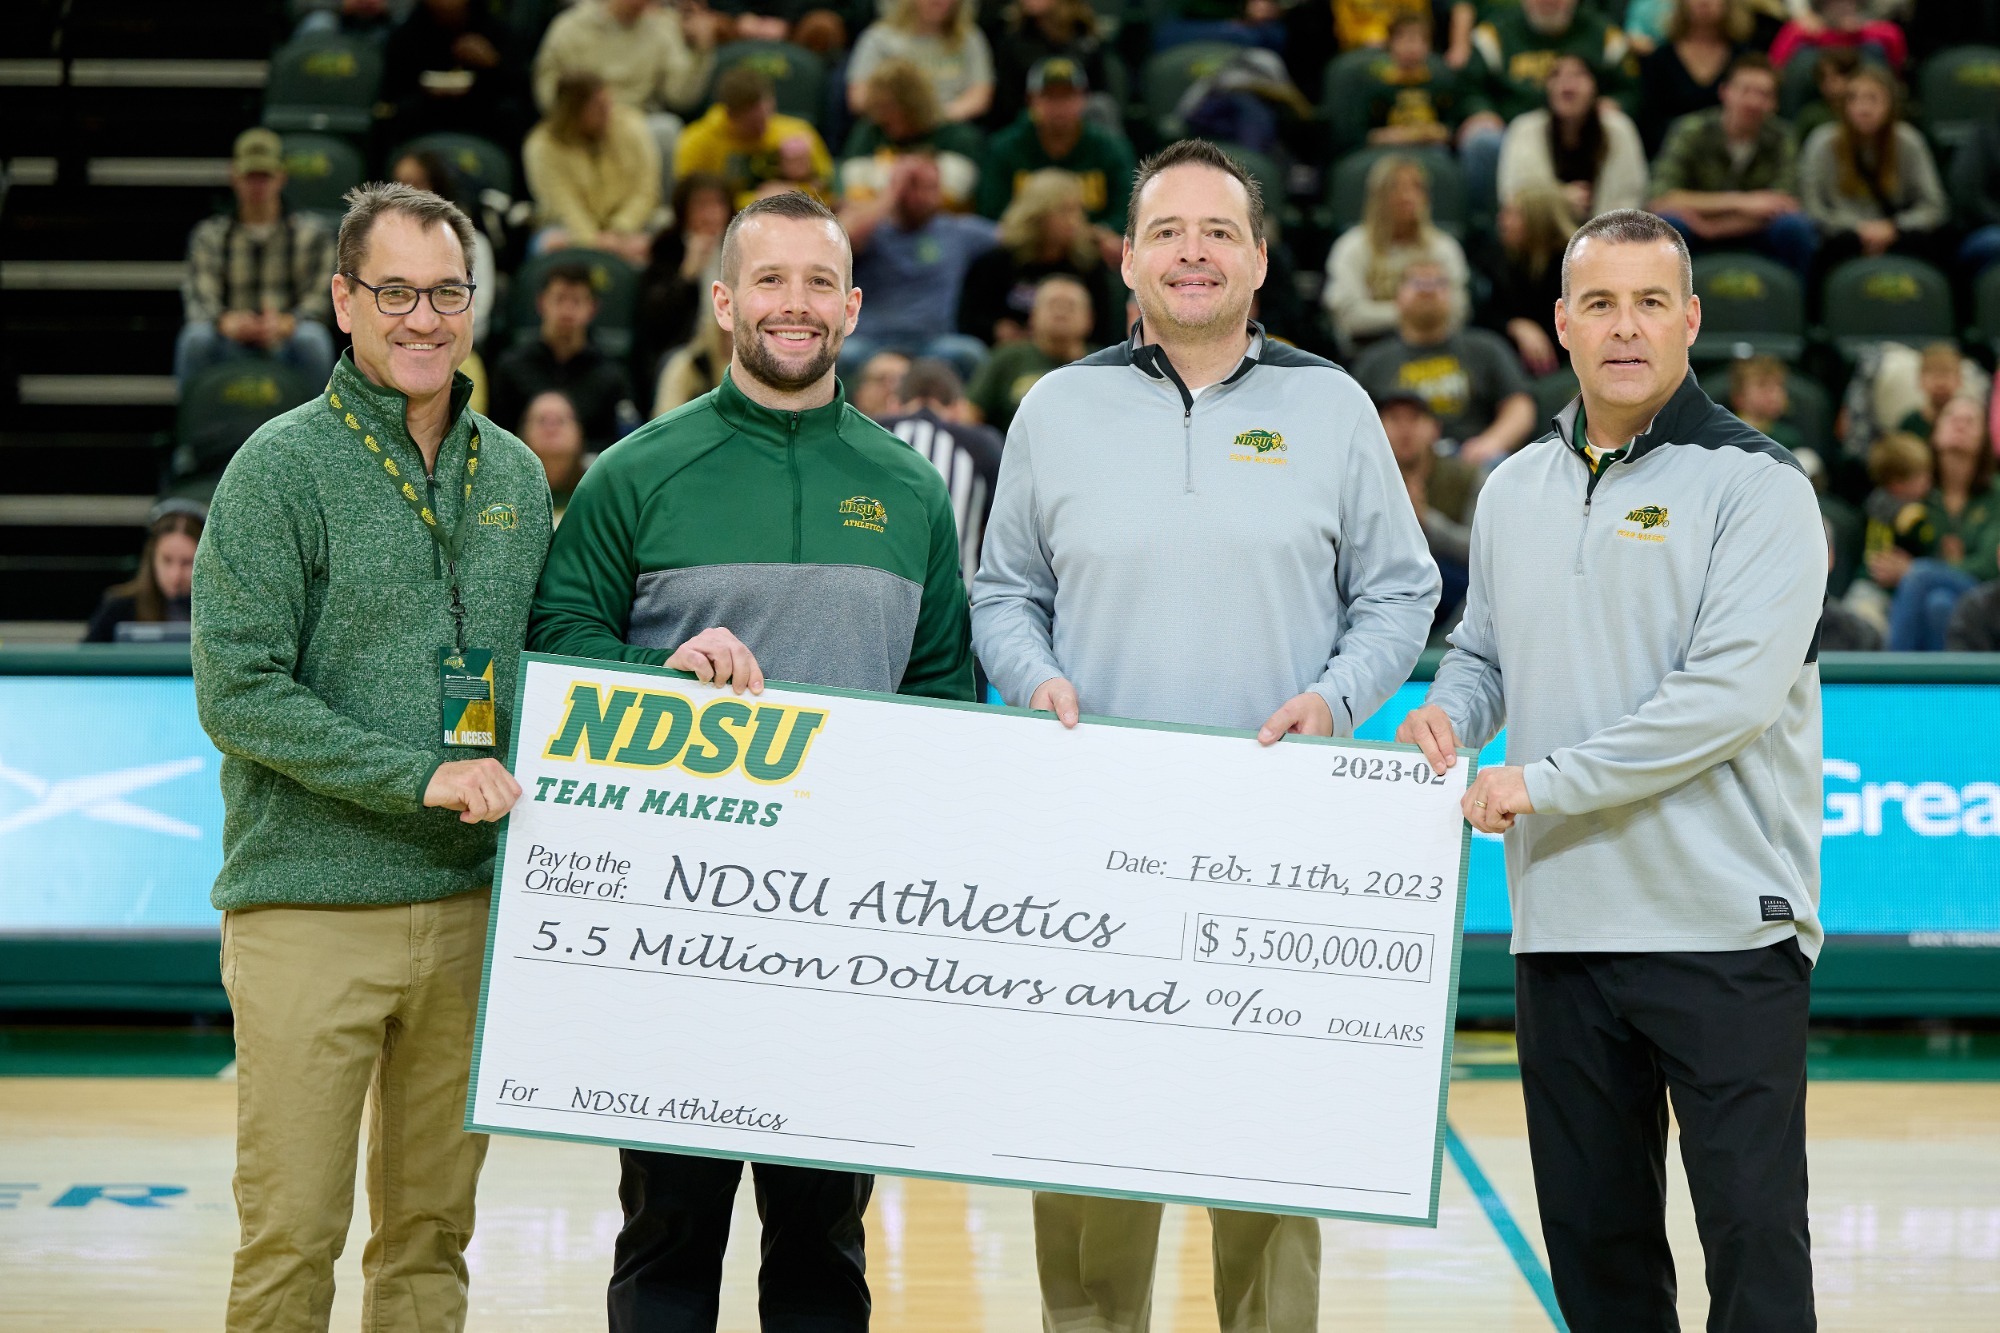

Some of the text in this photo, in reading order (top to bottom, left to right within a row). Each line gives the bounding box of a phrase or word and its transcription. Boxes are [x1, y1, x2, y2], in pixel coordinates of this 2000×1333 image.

[1234, 434, 1270, 448] NDSU
[839, 500, 875, 516] NDSU
[843, 519, 885, 533] ATHLETICS
[1625, 510, 1659, 524] NDSU
[444, 729, 493, 746] ALL ACCESS
[543, 682, 828, 784] NDSU
[534, 776, 783, 828] TEAM MAKERS
[527, 844, 631, 875] Pay to the
[1106, 850, 1444, 901] Date: Feb. 11th, 2023
[525, 868, 628, 900] Order of:
[663, 854, 1127, 949] NDSU Athletics
[1231, 927, 1423, 973] 5,500,000.00
[532, 920, 610, 957] 5.5
[629, 927, 840, 980] Million
[847, 954, 1057, 1005] Dollars
[1065, 980, 1191, 1015] and
[1327, 1018, 1426, 1042] DOLLARS
[499, 1079, 788, 1131] For NDSU Athletics
